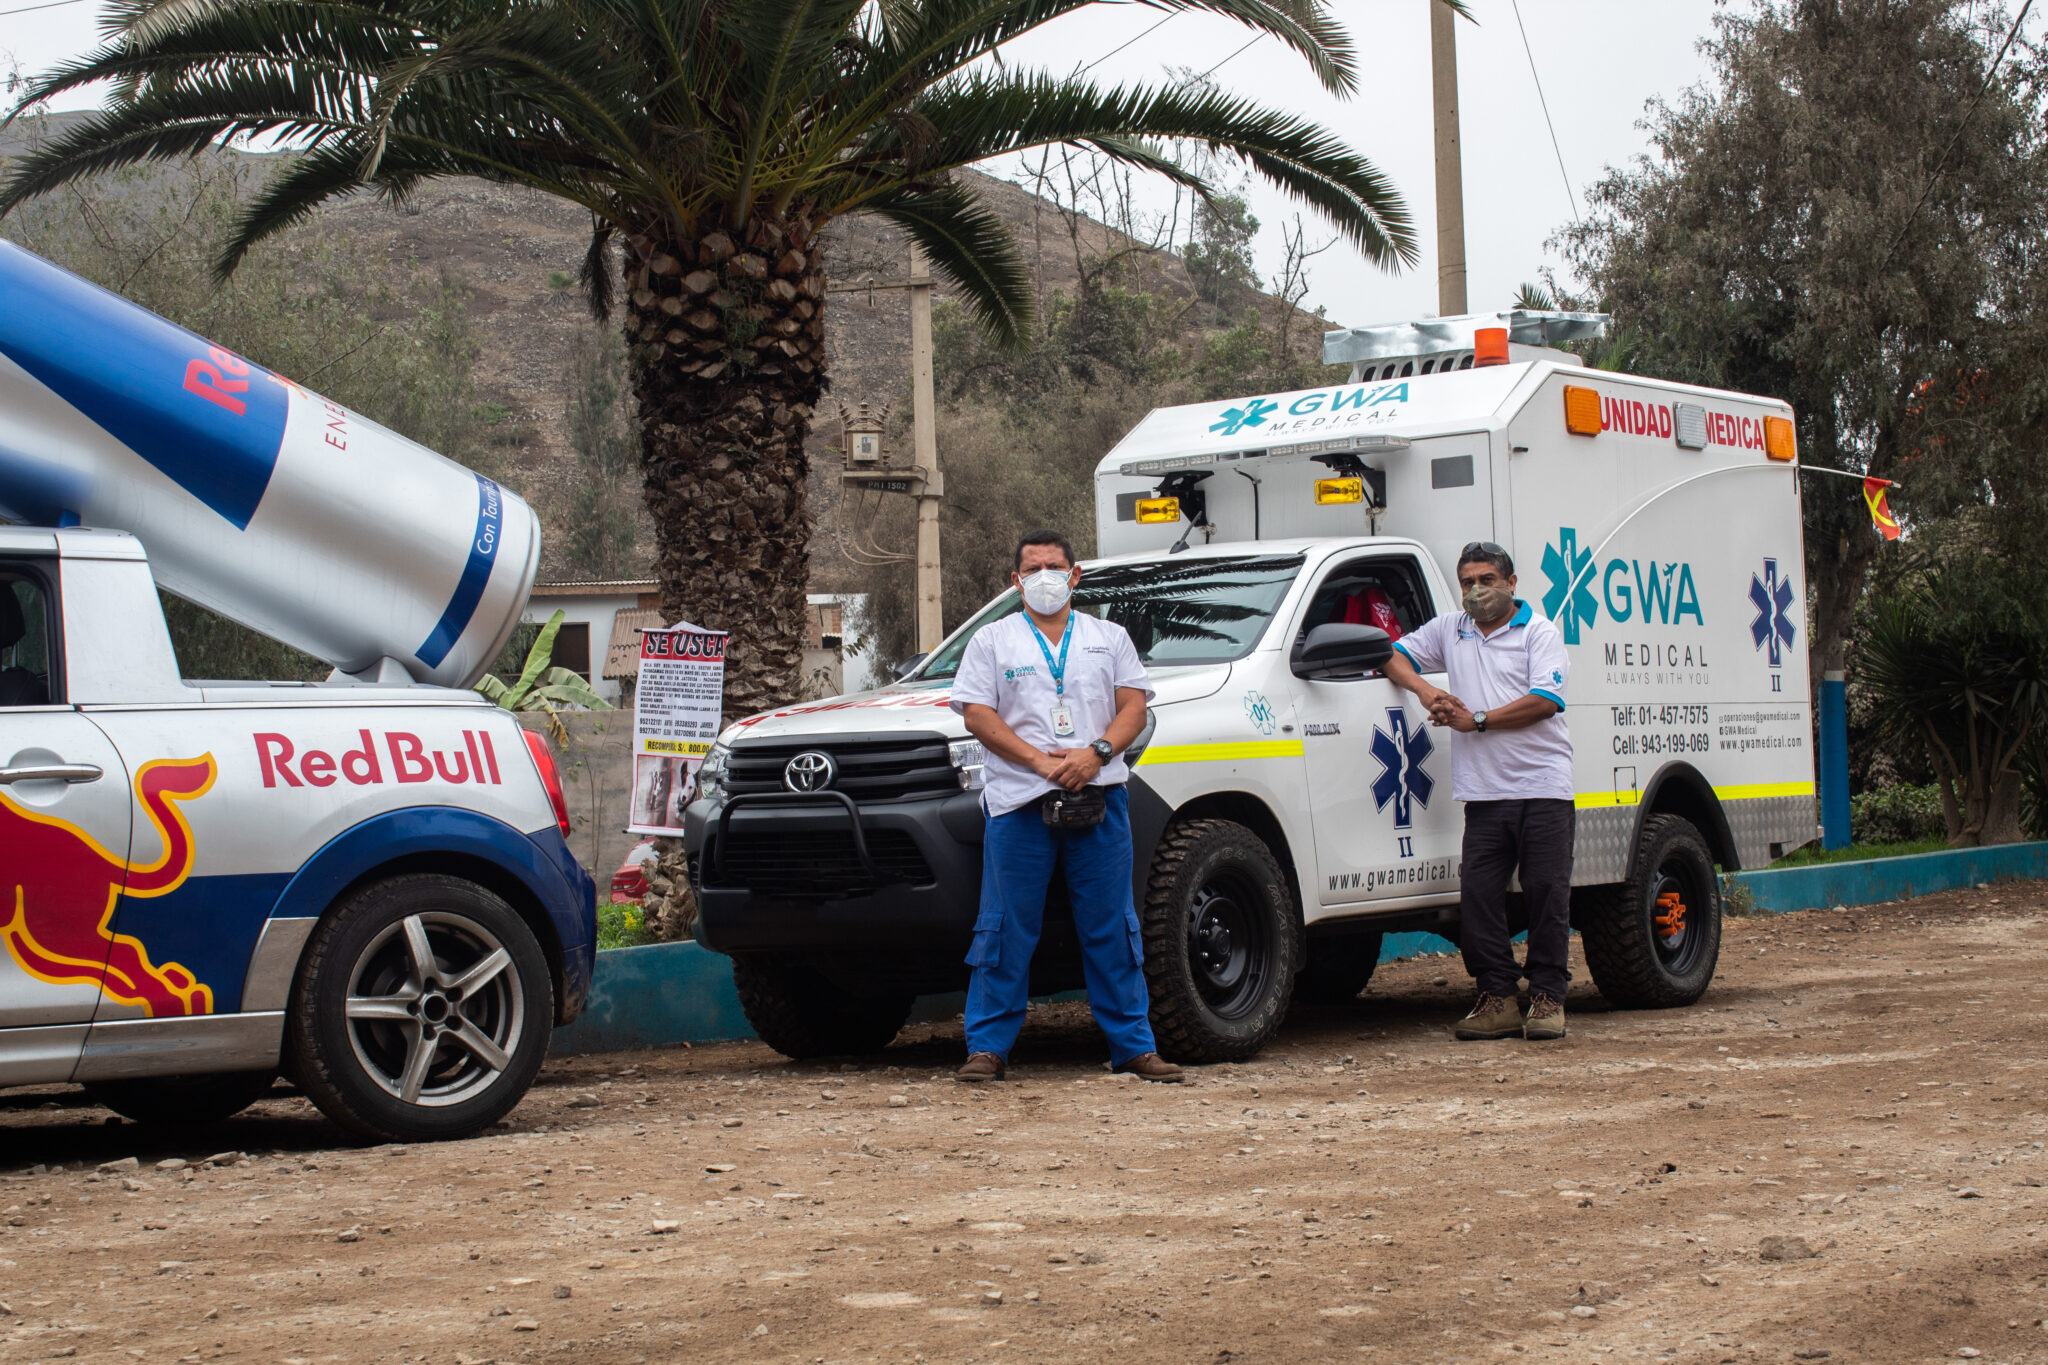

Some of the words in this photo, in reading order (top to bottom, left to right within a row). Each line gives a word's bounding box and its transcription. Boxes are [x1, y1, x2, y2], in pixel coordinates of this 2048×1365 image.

[1288, 383, 1409, 416] GWA
[1269, 409, 1398, 431] MEDICAL
[1600, 396, 1672, 439] UNIDAD
[1706, 411, 1764, 451] MEDICA
[477, 524, 496, 554] Con
[1603, 558, 1704, 626] GWA
[646, 632, 669, 655] SE
[672, 632, 724, 657] USCA
[1605, 642, 1708, 667] MEDICAL
[1606, 672, 1650, 684] ALWAYS
[1656, 672, 1683, 684] WITH
[1689, 673, 1709, 685] YOU
[1771, 674, 1781, 692] II
[1253, 704, 1269, 721] 01
[1611, 706, 1636, 726] Telf:
[1724, 711, 1800, 723] operaciones@gwamedical.com
[1304, 723, 1341, 736] HILUX
[1725, 726, 1736, 735] GWA
[1737, 726, 1757, 735] Medical
[1613, 735, 1639, 755] Cell:
[1641, 733, 1709, 754] 943-199-069
[1720, 735, 1802, 752] www.gwamedical.com
[253, 728, 383, 788] Red
[384, 729, 502, 785] Bull
[1398, 836, 1414, 858] II
